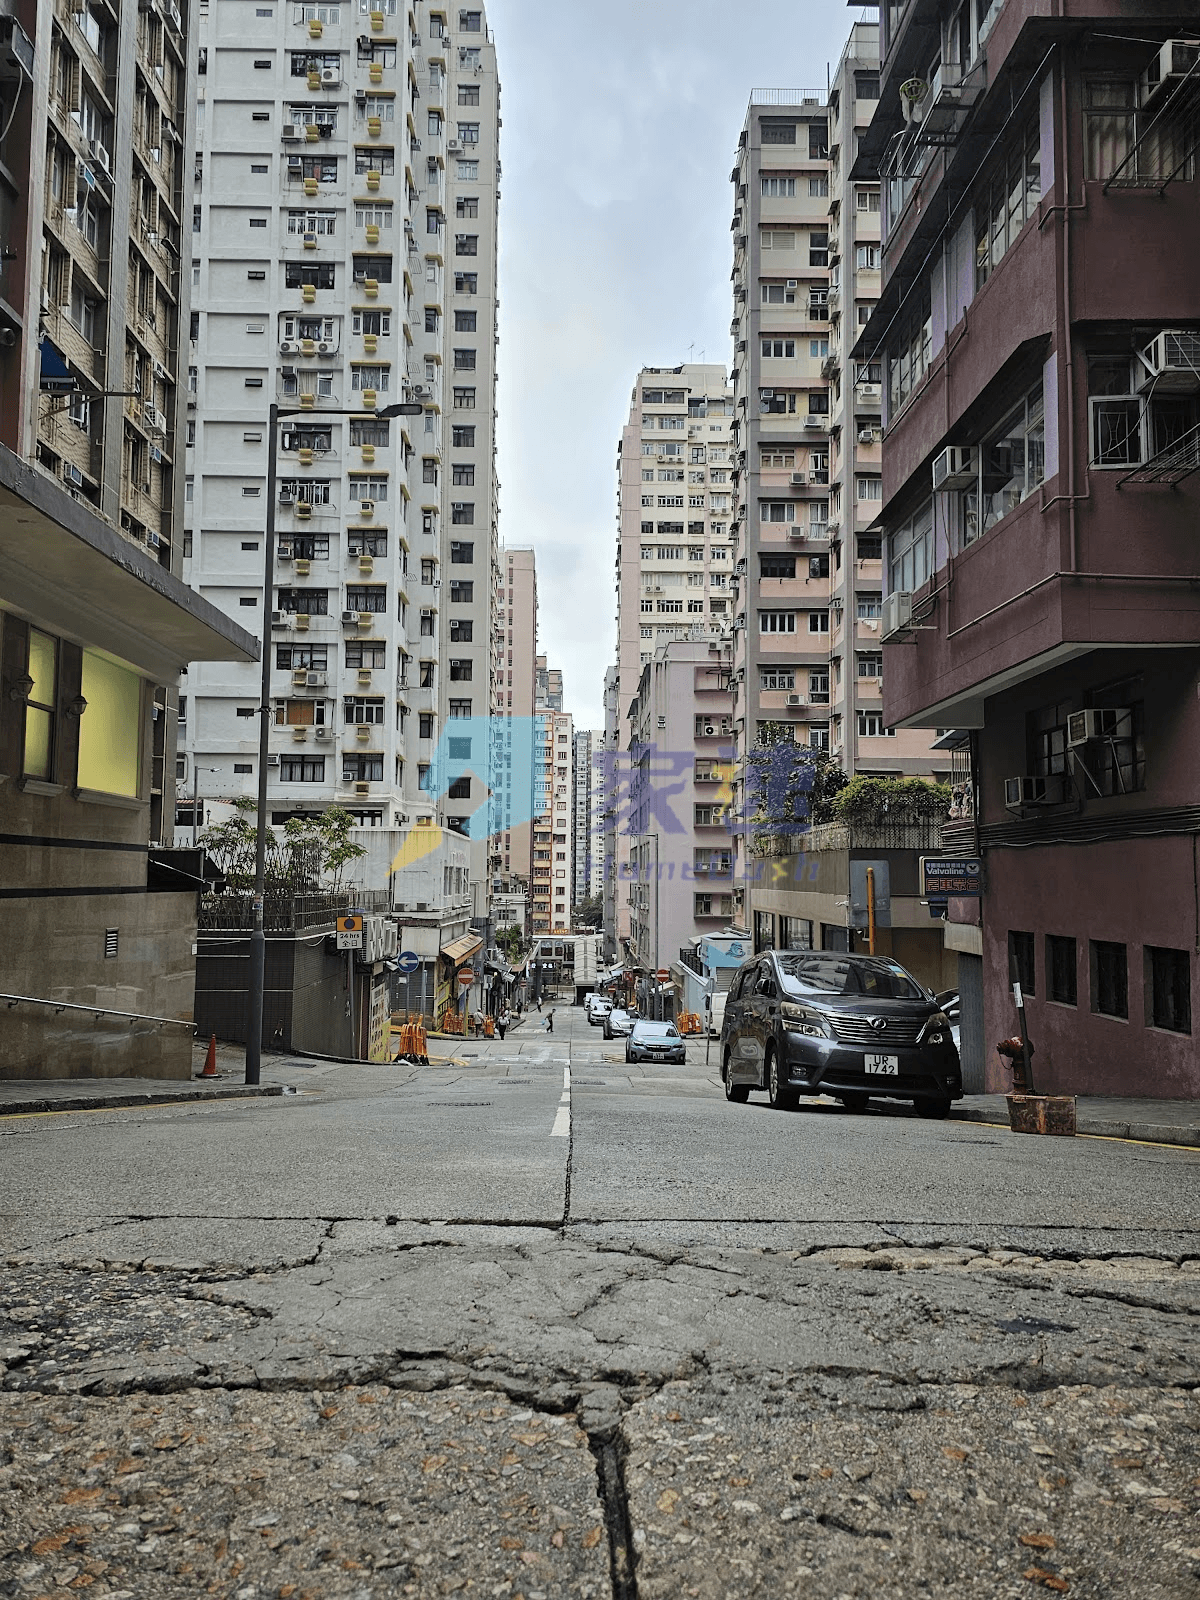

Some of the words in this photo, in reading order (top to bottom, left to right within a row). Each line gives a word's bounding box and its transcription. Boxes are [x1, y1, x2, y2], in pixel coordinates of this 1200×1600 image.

[342, 940, 358, 948] 全日
[874, 1055, 889, 1065] UR
[869, 1064, 895, 1074] 1742
